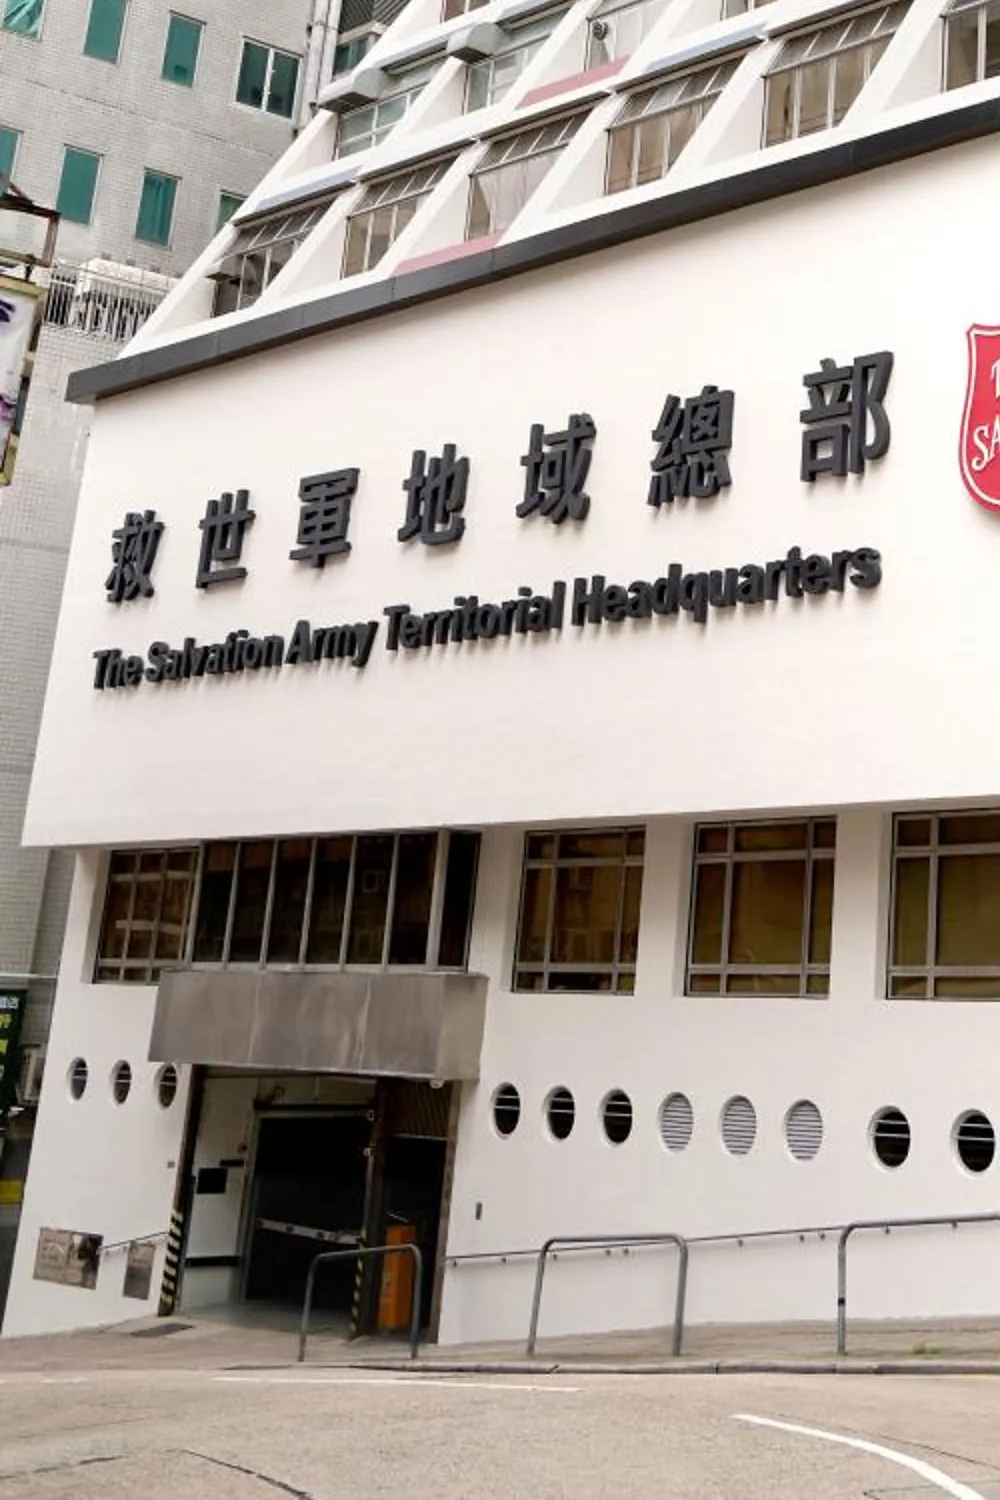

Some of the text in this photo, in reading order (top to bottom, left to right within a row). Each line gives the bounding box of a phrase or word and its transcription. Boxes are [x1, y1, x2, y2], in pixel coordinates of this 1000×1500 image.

[105, 350, 895, 603] 救世軍地域總部
[94, 546, 882, 689] The Salvation Army Territorial Headquarters
